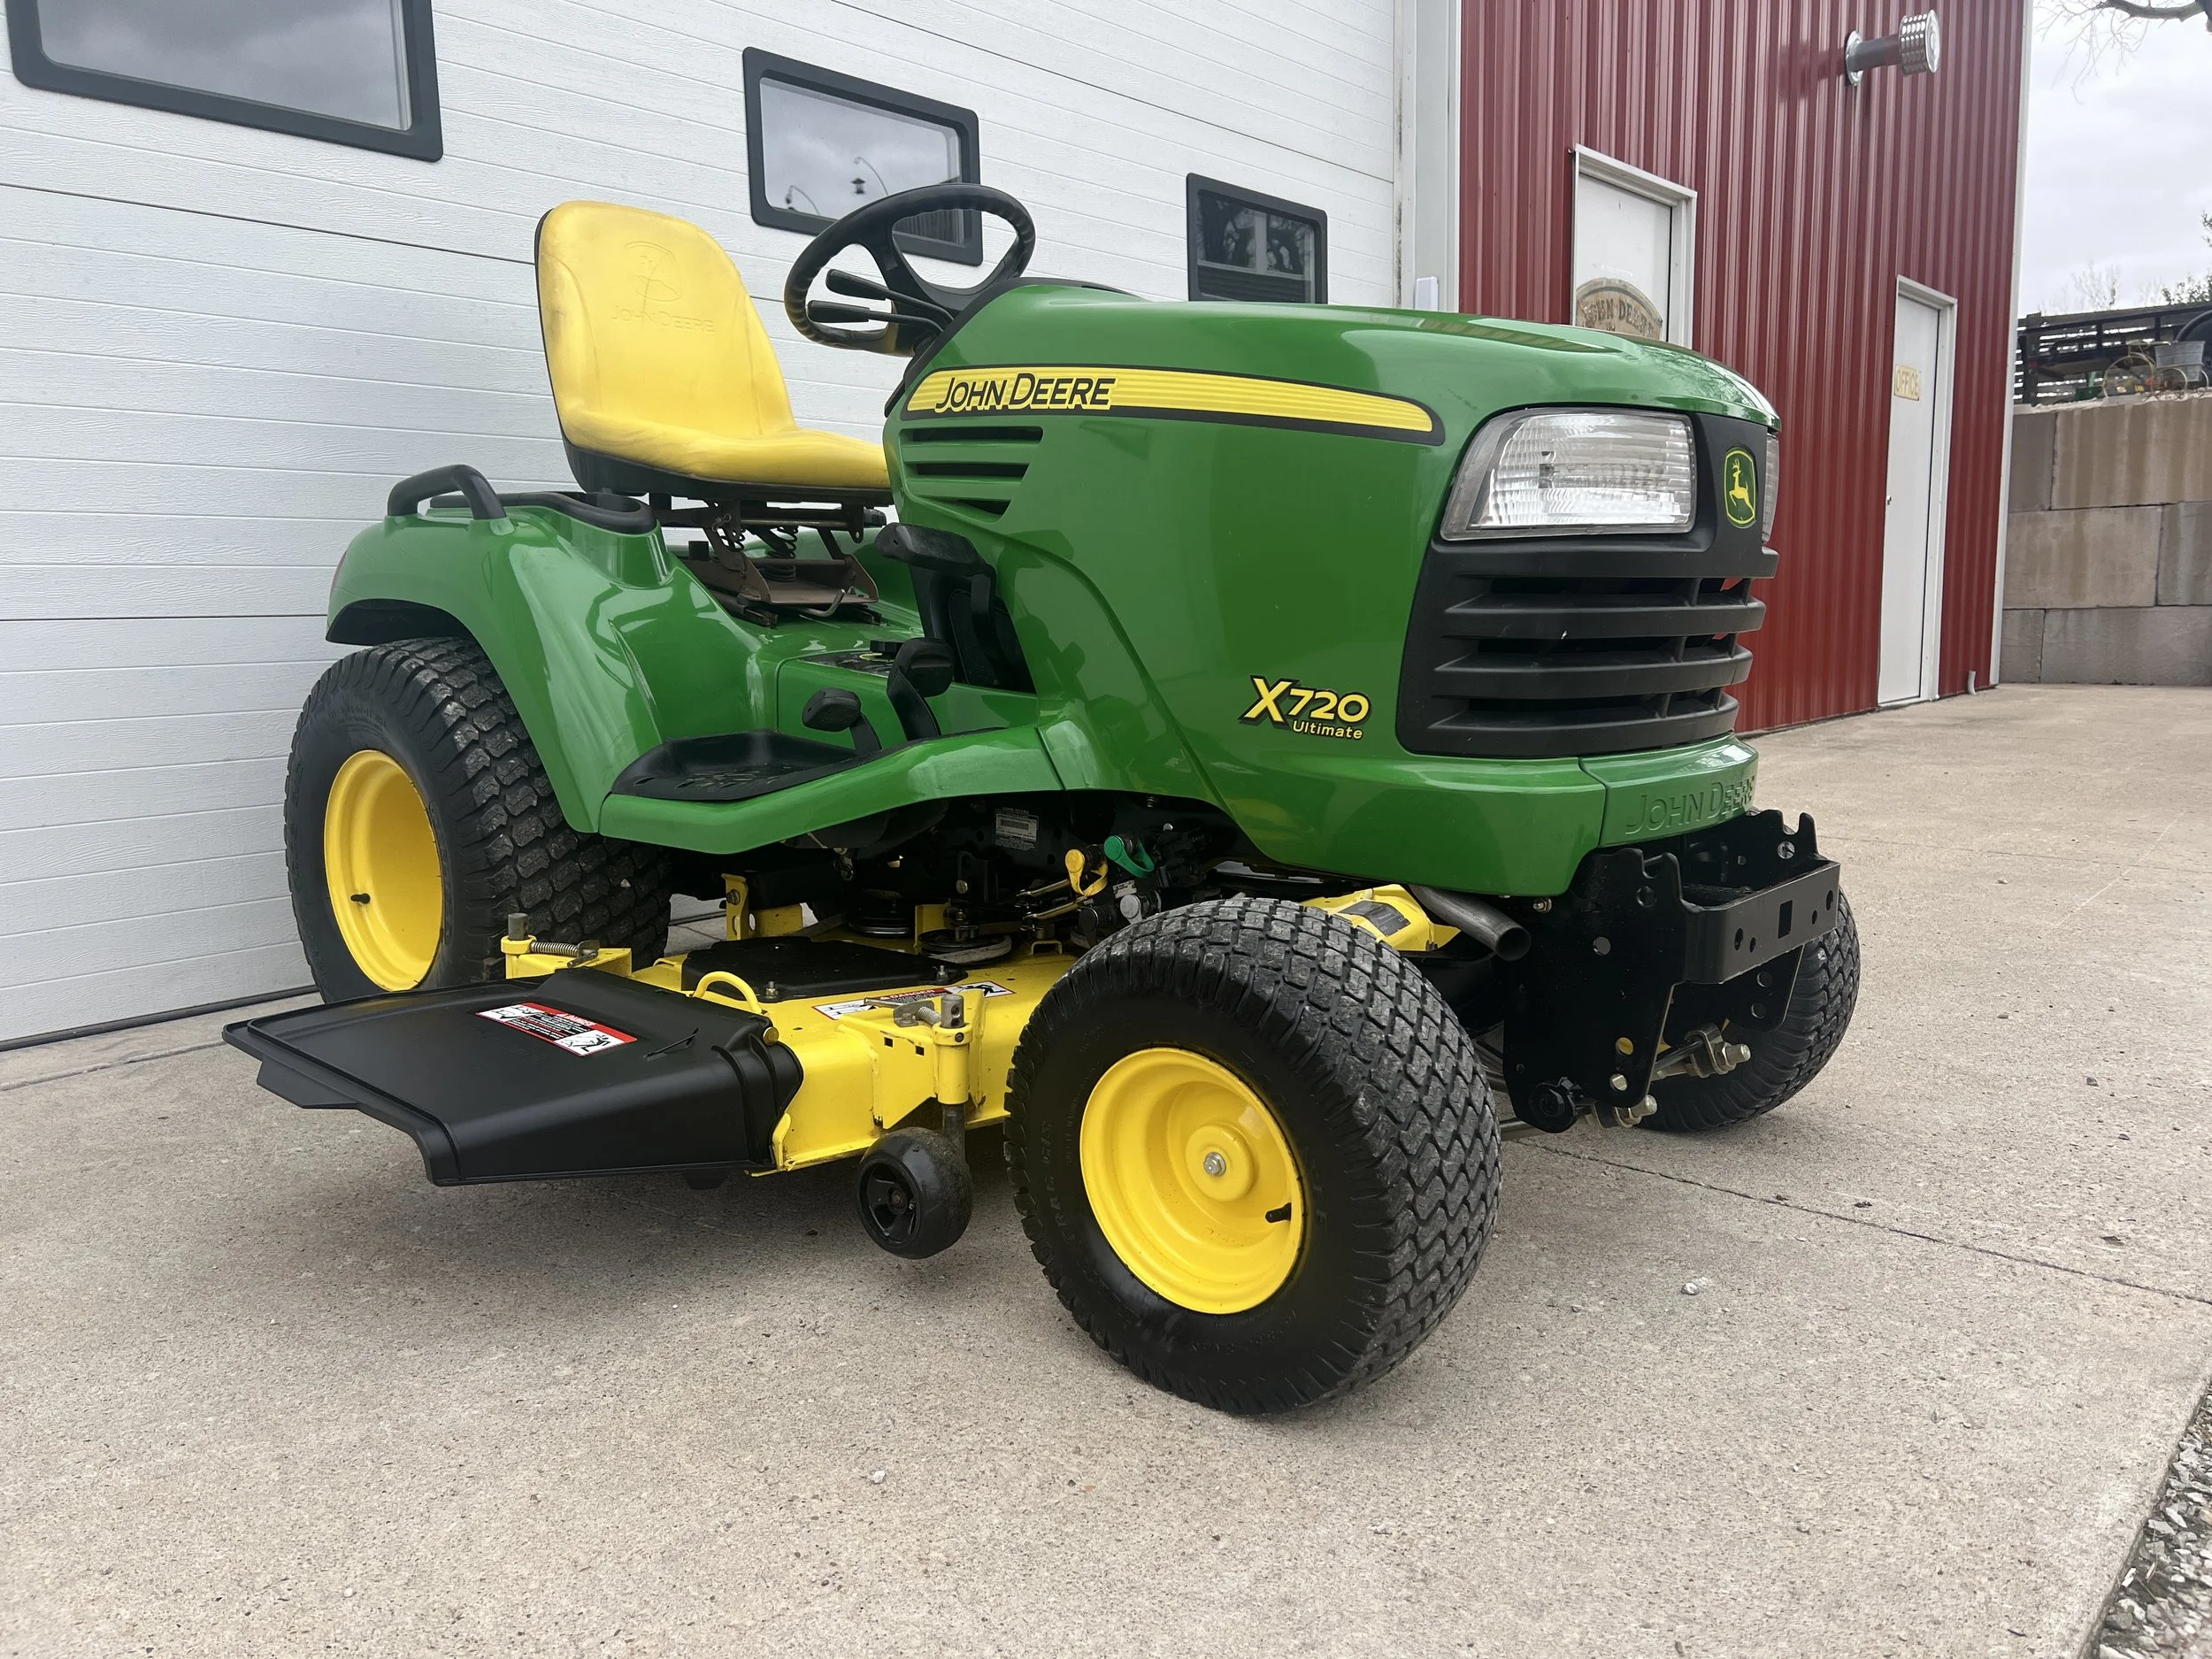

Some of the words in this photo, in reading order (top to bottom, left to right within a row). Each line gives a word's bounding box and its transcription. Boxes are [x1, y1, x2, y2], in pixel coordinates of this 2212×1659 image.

[658, 311, 716, 334] DEERE
[935, 377, 1008, 410] JOHN
[1009, 373, 1117, 406] DEERE
[1895, 368, 1918, 396] OFFICE
[1242, 677, 1371, 724] X720
[1293, 720, 1363, 740] Ultimate
[1624, 791, 1704, 834] JOHN
[1707, 775, 1755, 818] DEERE
